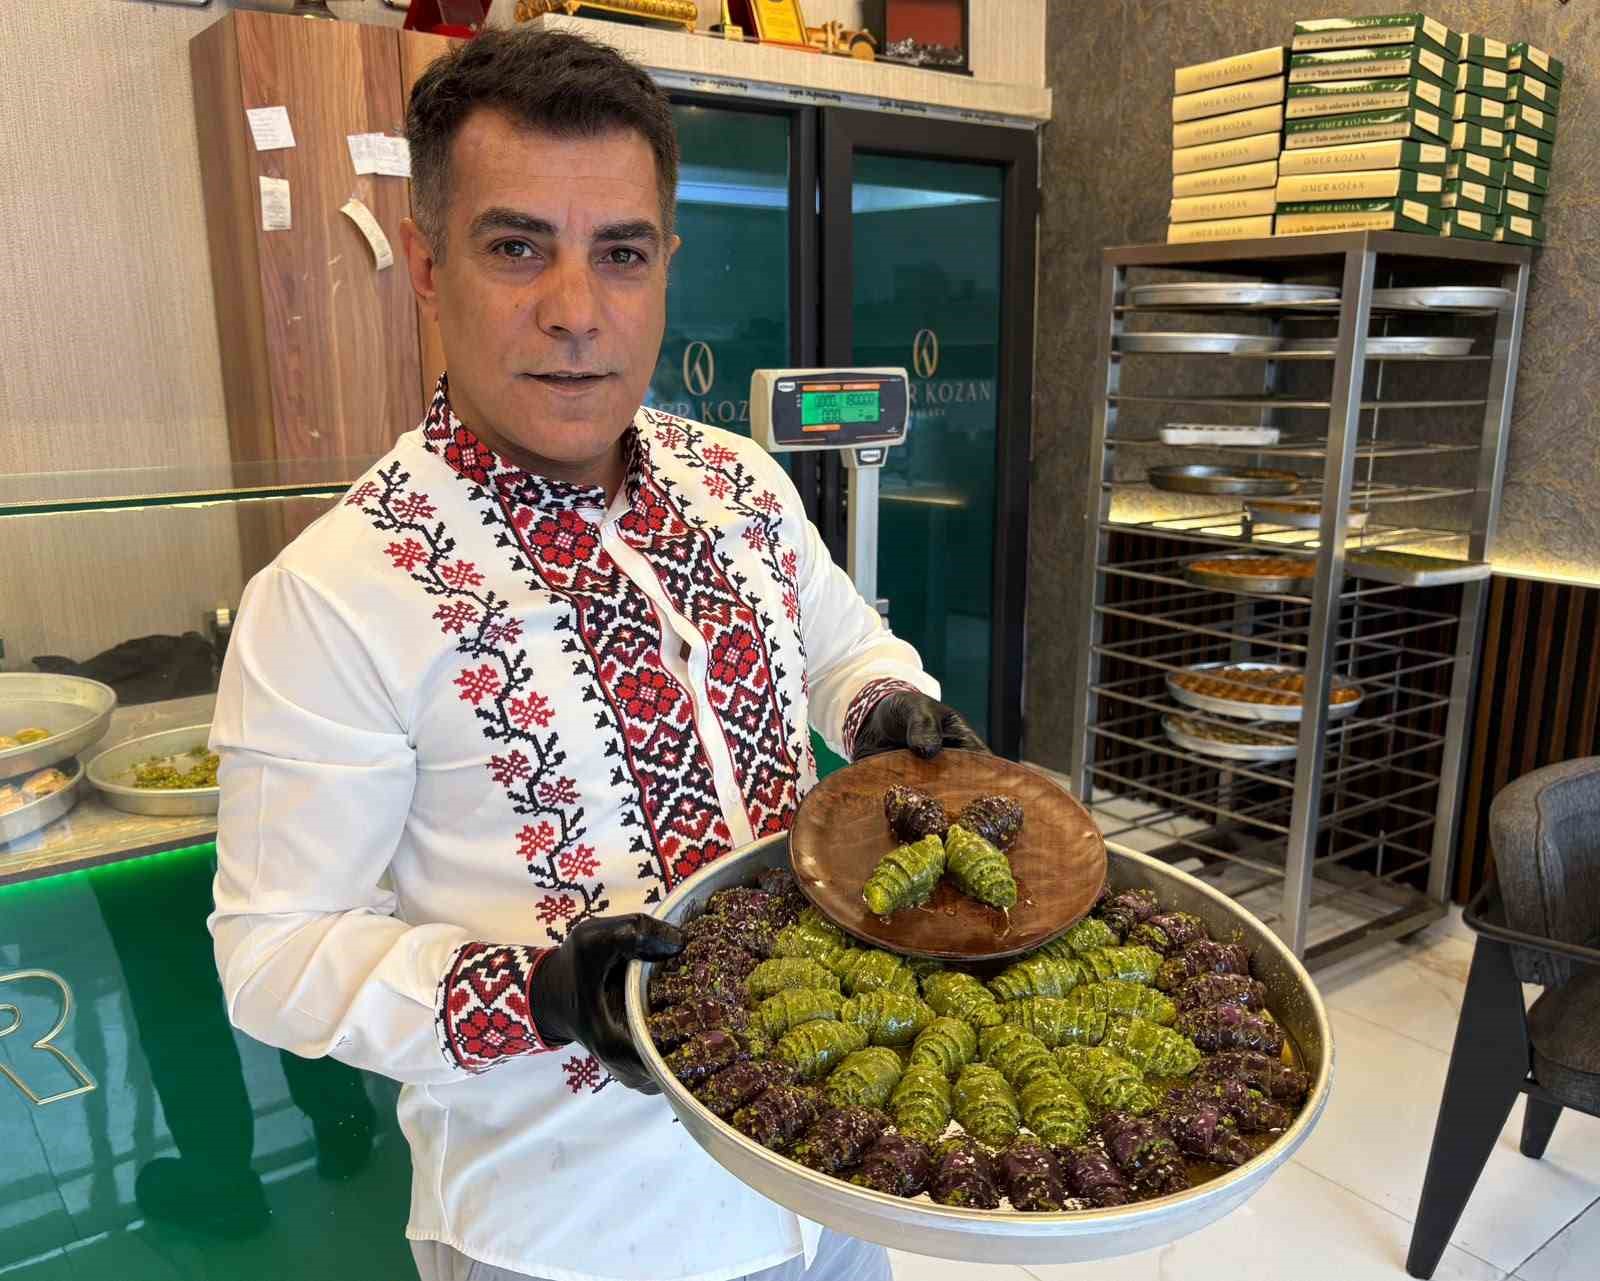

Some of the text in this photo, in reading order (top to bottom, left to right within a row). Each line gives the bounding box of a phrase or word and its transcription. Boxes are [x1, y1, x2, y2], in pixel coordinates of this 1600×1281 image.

[1333, 151, 1368, 162] KOZAN
[1331, 181, 1366, 191] KOZAN
[925, 380, 992, 403] KOZAN
[701, 399, 749, 423] KOZ
